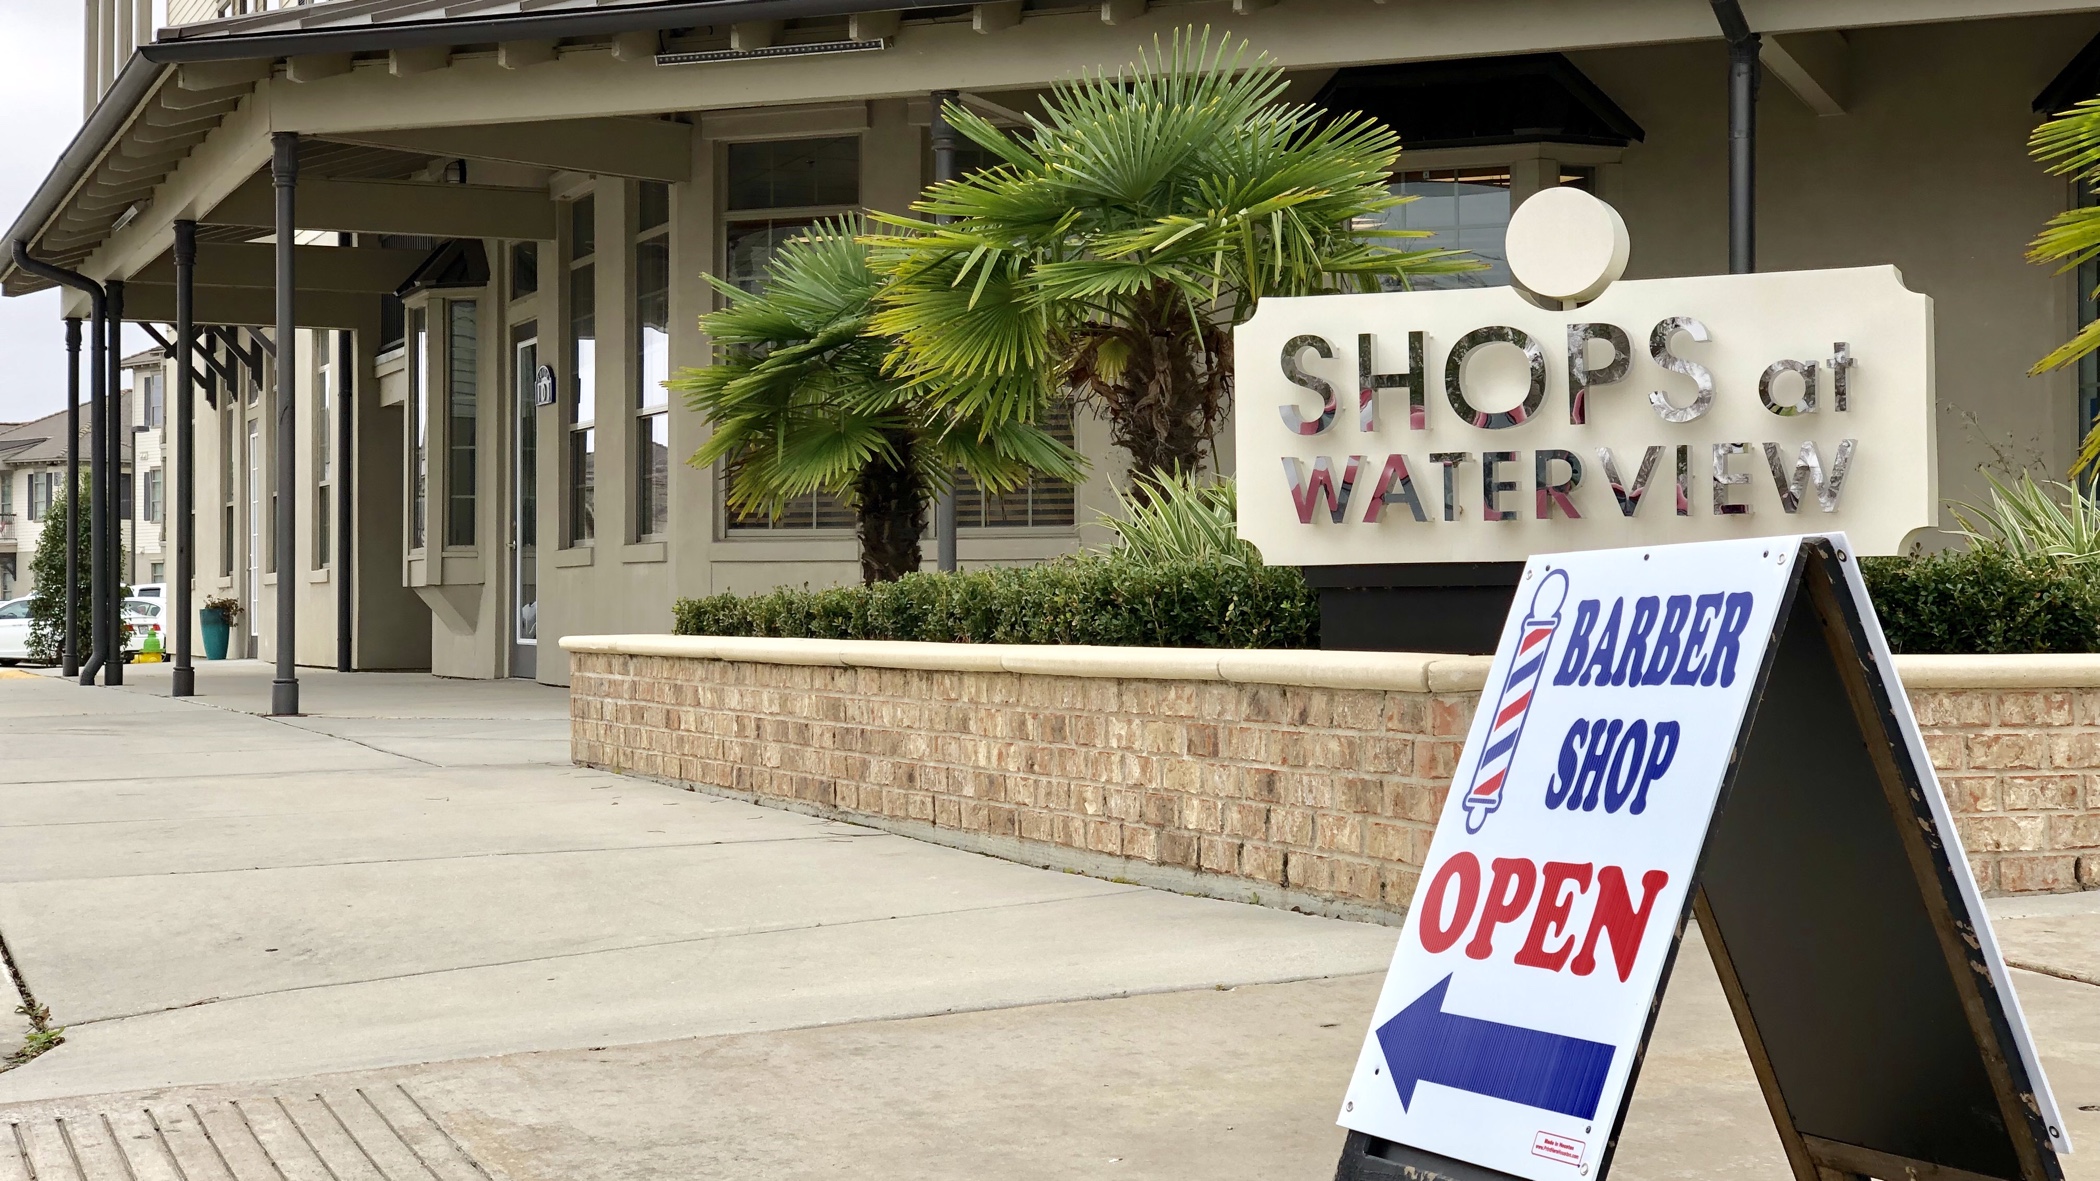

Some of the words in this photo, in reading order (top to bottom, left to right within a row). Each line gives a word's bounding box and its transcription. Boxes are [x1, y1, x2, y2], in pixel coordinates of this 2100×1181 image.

[1279, 316, 1713, 436] SHOPS
[1758, 341, 1859, 417] at
[1281, 439, 1858, 525] WATERVIEW
[1553, 591, 1753, 688] BARBER
[1545, 718, 1681, 815] SHOP
[1419, 851, 1669, 983] OPEN
